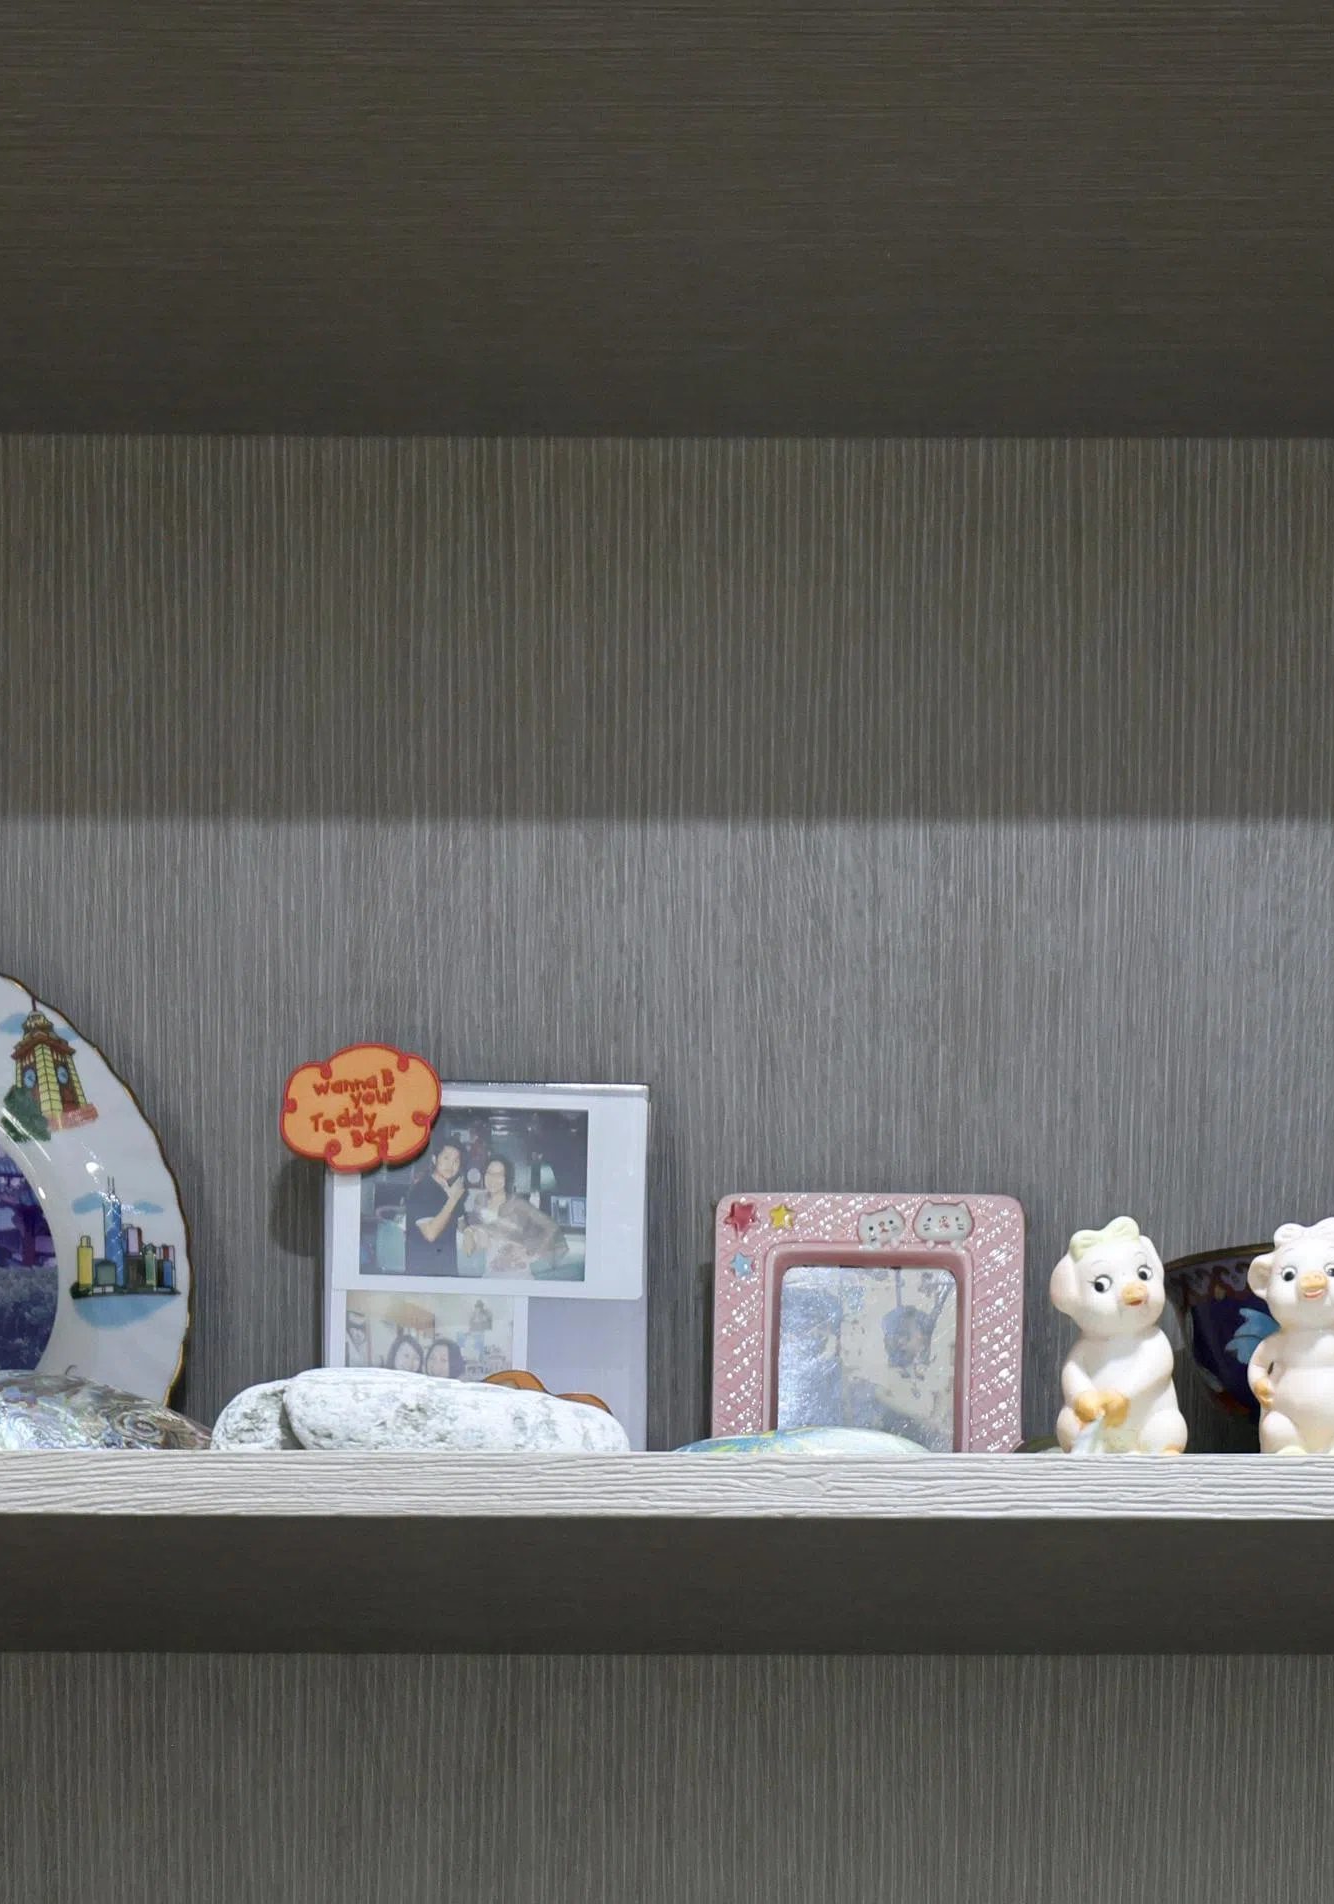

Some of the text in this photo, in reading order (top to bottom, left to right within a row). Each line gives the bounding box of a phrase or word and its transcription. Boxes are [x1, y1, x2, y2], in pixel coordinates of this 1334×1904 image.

[313, 1069, 395, 1097] wanna B
[350, 1087, 396, 1110] your
[310, 1107, 377, 1134] Teddy
